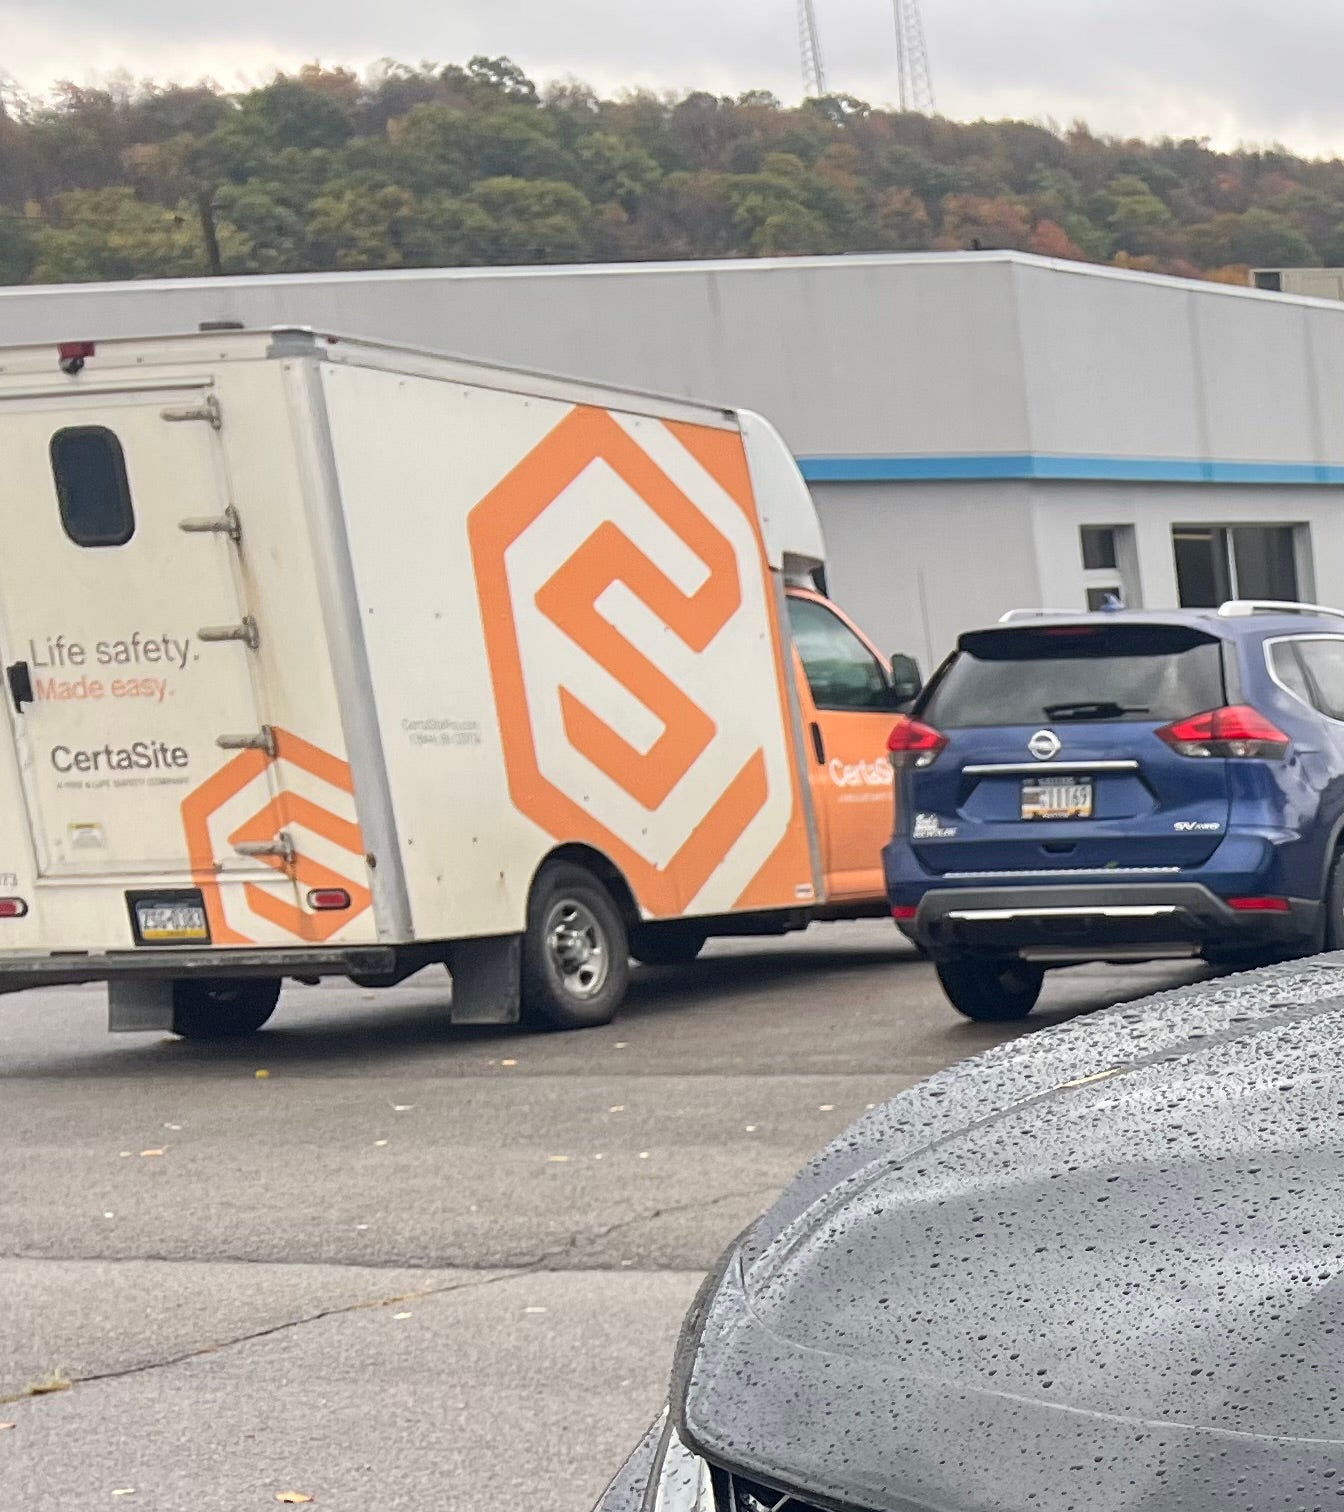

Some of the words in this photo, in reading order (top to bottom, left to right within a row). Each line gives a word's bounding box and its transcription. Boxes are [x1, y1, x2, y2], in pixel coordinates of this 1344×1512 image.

[29, 635, 86, 667] Life
[95, 631, 200, 669] safety.
[35, 675, 105, 701] Made
[110, 678, 175, 703] easy.
[50, 741, 189, 773] CertaSite
